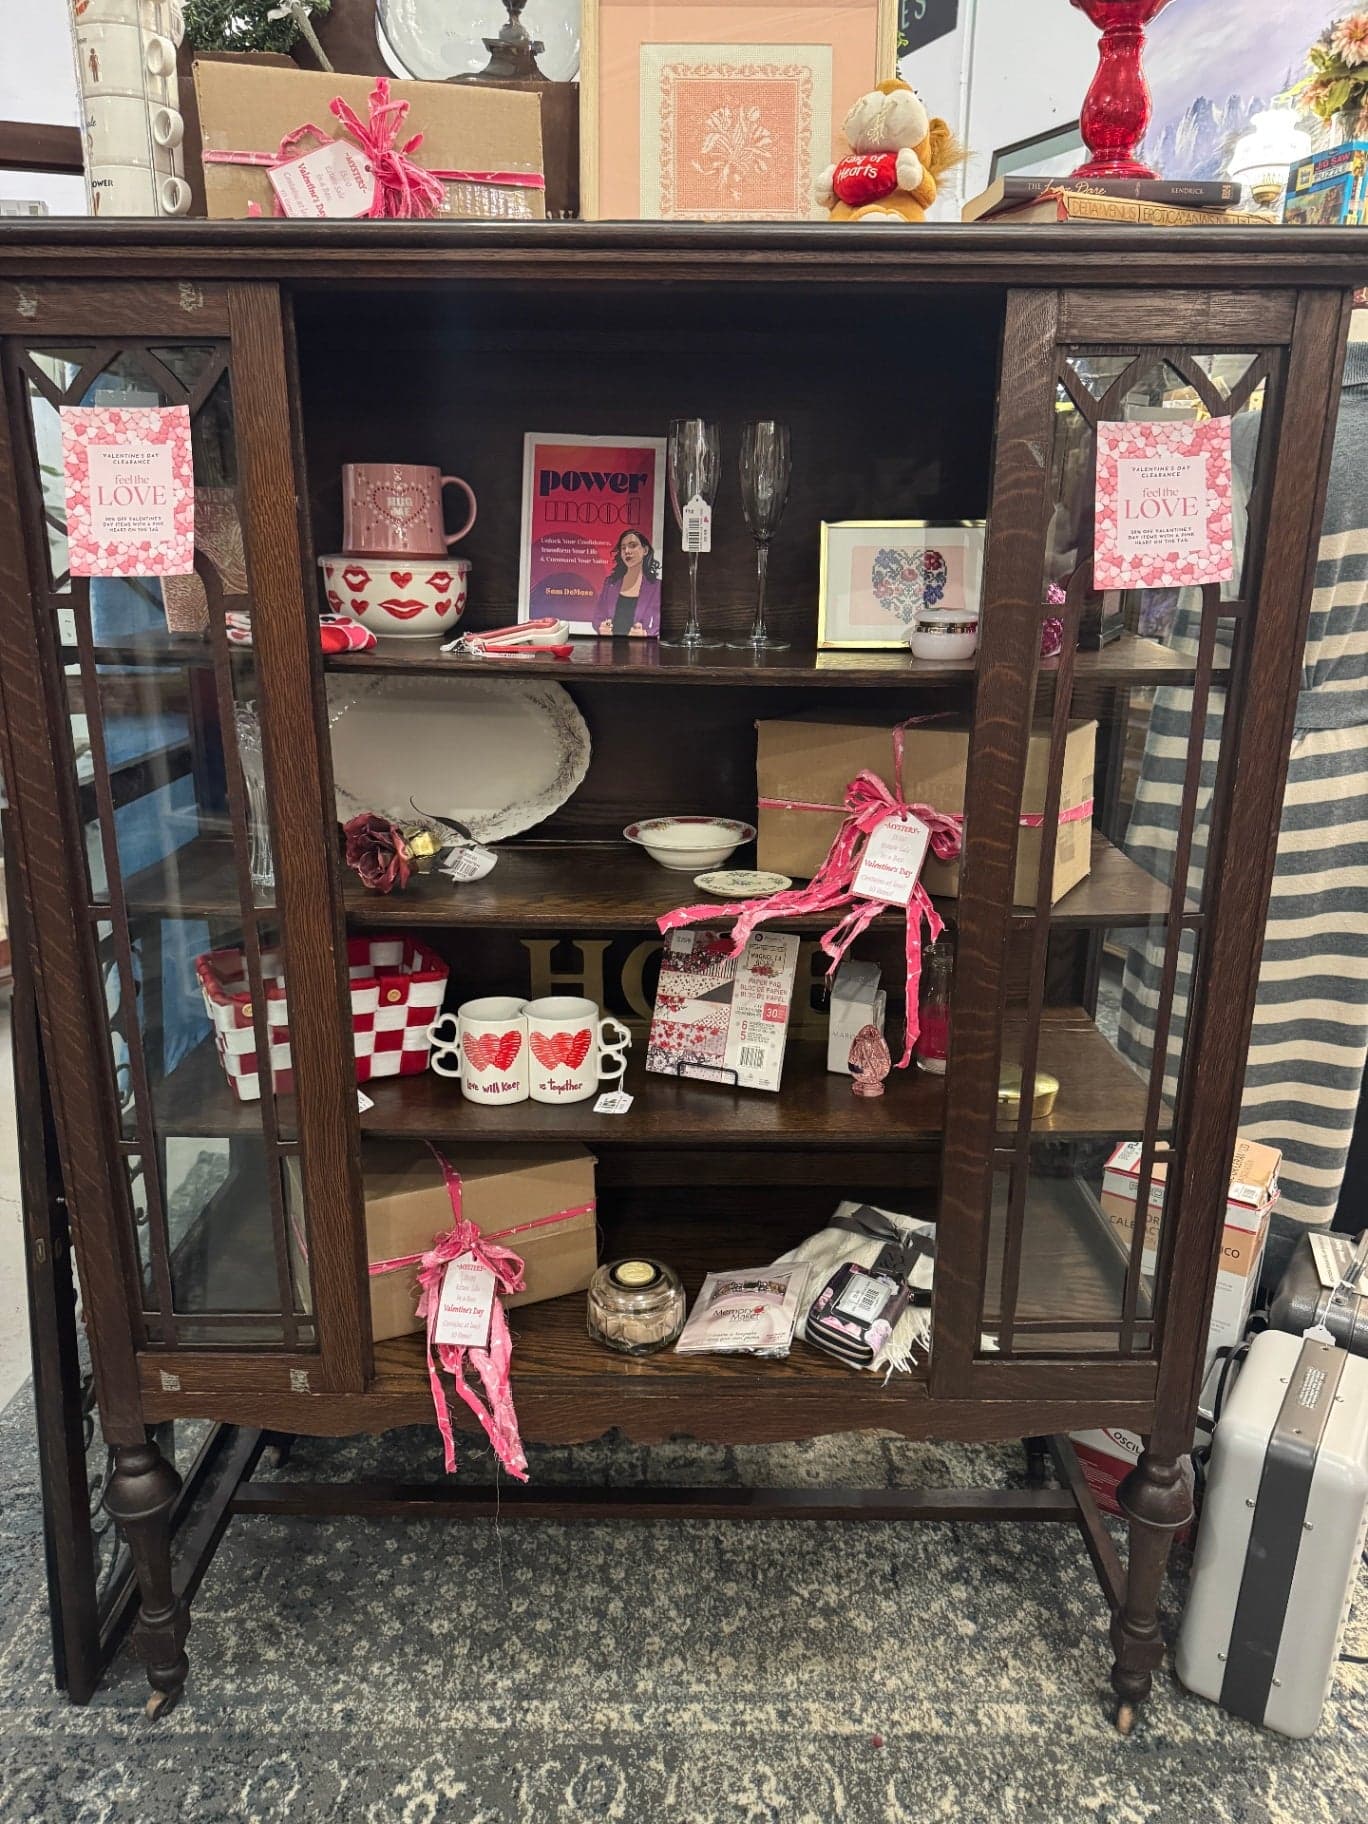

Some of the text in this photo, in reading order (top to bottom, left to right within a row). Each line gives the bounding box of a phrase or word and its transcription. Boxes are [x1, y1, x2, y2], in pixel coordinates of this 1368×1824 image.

[870, 154, 887, 163] of
[837, 164, 878, 184] Hearts
[1027, 182, 1041, 191] THE
[1076, 181, 1107, 195] Dare
[1171, 187, 1204, 195] KENDRICK
[115, 474, 150, 485] feel the
[540, 469, 648, 496] power
[98, 485, 167, 506] LOVE
[1142, 487, 1179, 498] feel the
[545, 497, 641, 526] mood
[1124, 496, 1198, 520] LOVE
[766, 1007, 778, 1019] 30
[742, 1020, 748, 1030] 6
[741, 1031, 747, 1041] 5
[482, 1083, 500, 1094] will
[548, 1078, 584, 1095] together
[473, 1305, 485, 1317] Day
[713, 1307, 753, 1320] Memory
